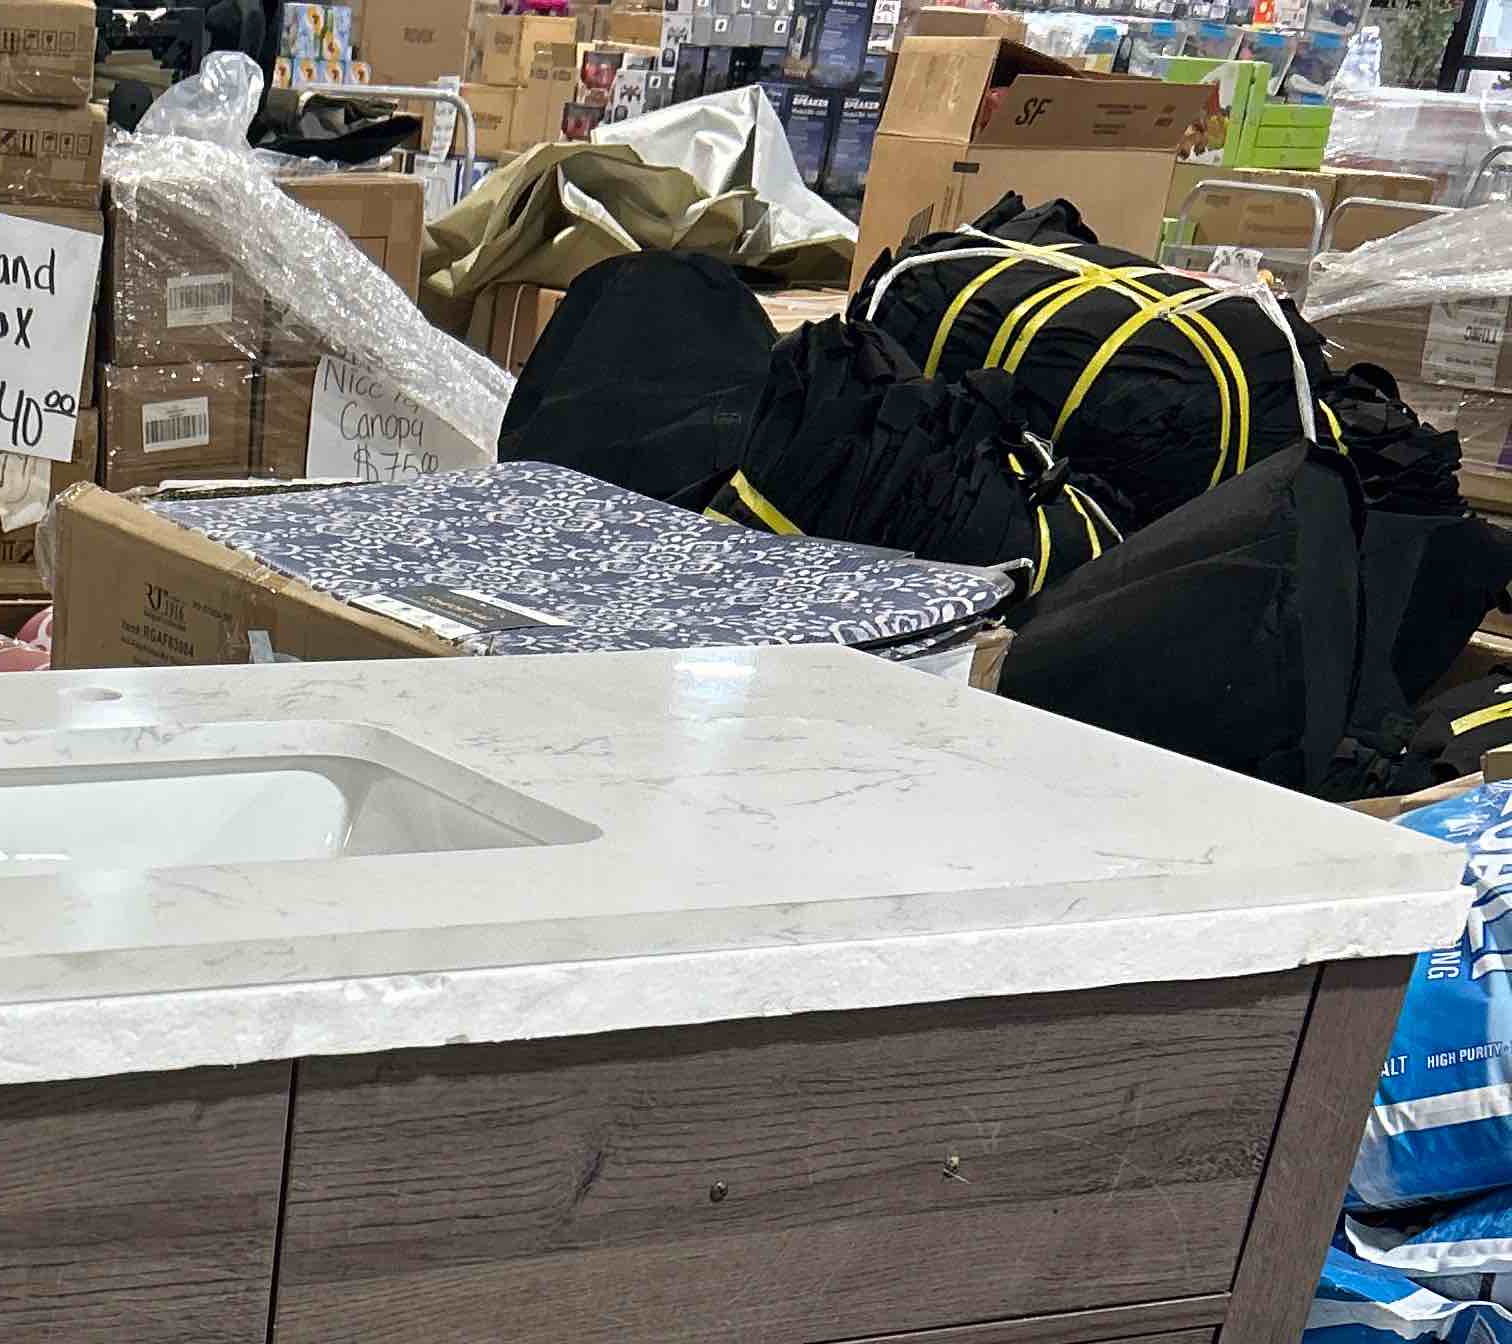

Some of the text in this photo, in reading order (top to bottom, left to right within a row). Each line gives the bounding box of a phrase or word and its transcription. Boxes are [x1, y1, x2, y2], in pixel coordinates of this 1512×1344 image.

[1015, 97, 1054, 126] SF
[340, 400, 424, 448] Canopy
[1380, 1042, 1502, 1078] ALT HIGH PURITY
